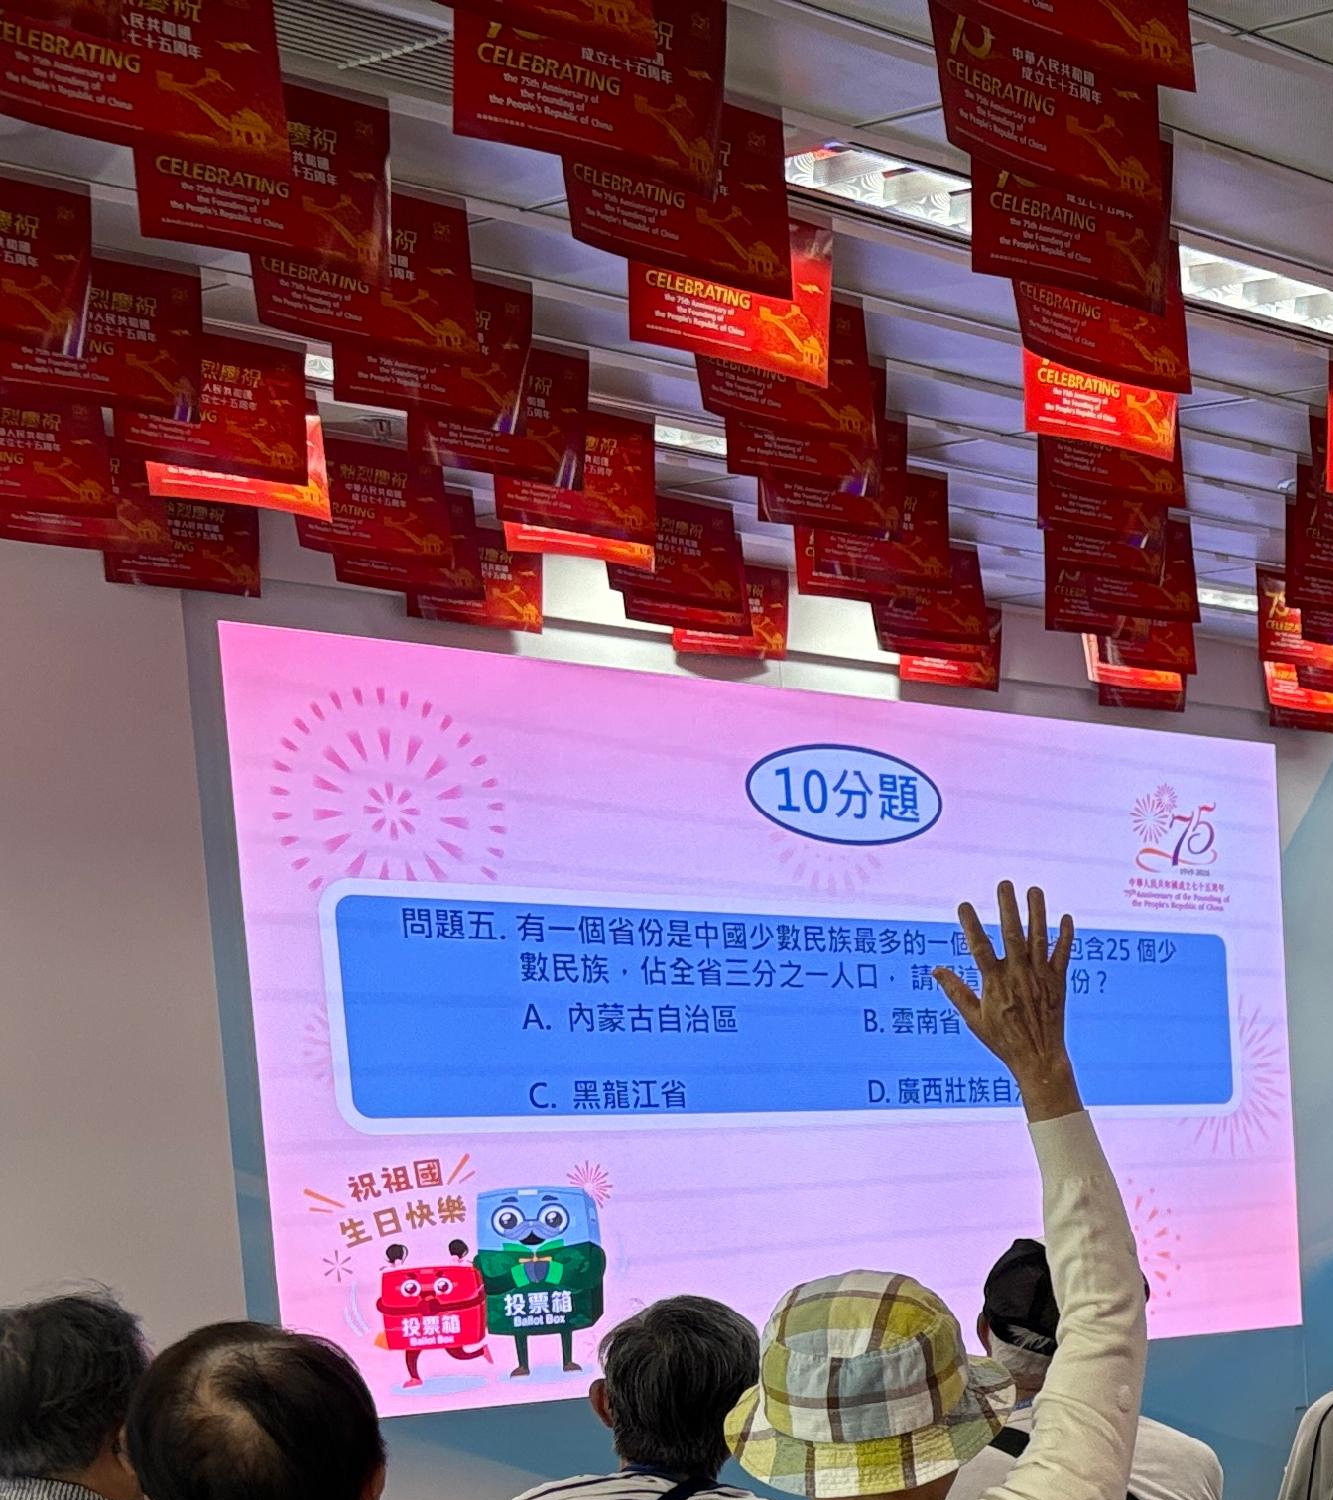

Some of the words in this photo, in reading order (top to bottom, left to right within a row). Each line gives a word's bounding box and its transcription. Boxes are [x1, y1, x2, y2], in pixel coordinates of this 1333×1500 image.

[477, 42, 621, 96] CELEBRATING
[1012, 46, 1094, 87] 中華人民共和國
[1022, 66, 1102, 105] 成立七十五周年
[536, 90, 574, 111] Founding
[542, 79, 589, 102] Anniversary
[946, 58, 1055, 116] CELEBRATING
[543, 104, 578, 124] Republic
[591, 117, 614, 132] China
[155, 155, 290, 199] CELEBRATING
[573, 163, 685, 210] CELEBRATING
[990, 191, 1096, 233] CELEBRATING
[645, 270, 751, 310] CELEBRATING
[1037, 367, 1121, 398] CELEBRATING
[775, 767, 919, 823] 10分題
[1170, 802, 1216, 866] 75
[522, 1003, 551, 1031] A.
[568, 1003, 738, 1033] 內蒙古自治區
[864, 1009, 884, 1033] B.
[892, 1008, 961, 1034] 雲南省
[529, 1082, 557, 1109] C.
[573, 1080, 687, 1110] 黑龍江省
[869, 1080, 890, 1103] D.
[899, 1076, 1024, 1104] 廣西壯族自
[348, 1159, 443, 1202] 祝祖國
[339, 1194, 467, 1248] 生日快樂
[504, 1290, 573, 1317] 投票箱
[514, 1314, 544, 1327] Ballot
[546, 1313, 566, 1325] Box
[402, 1314, 461, 1338] 投票箱
